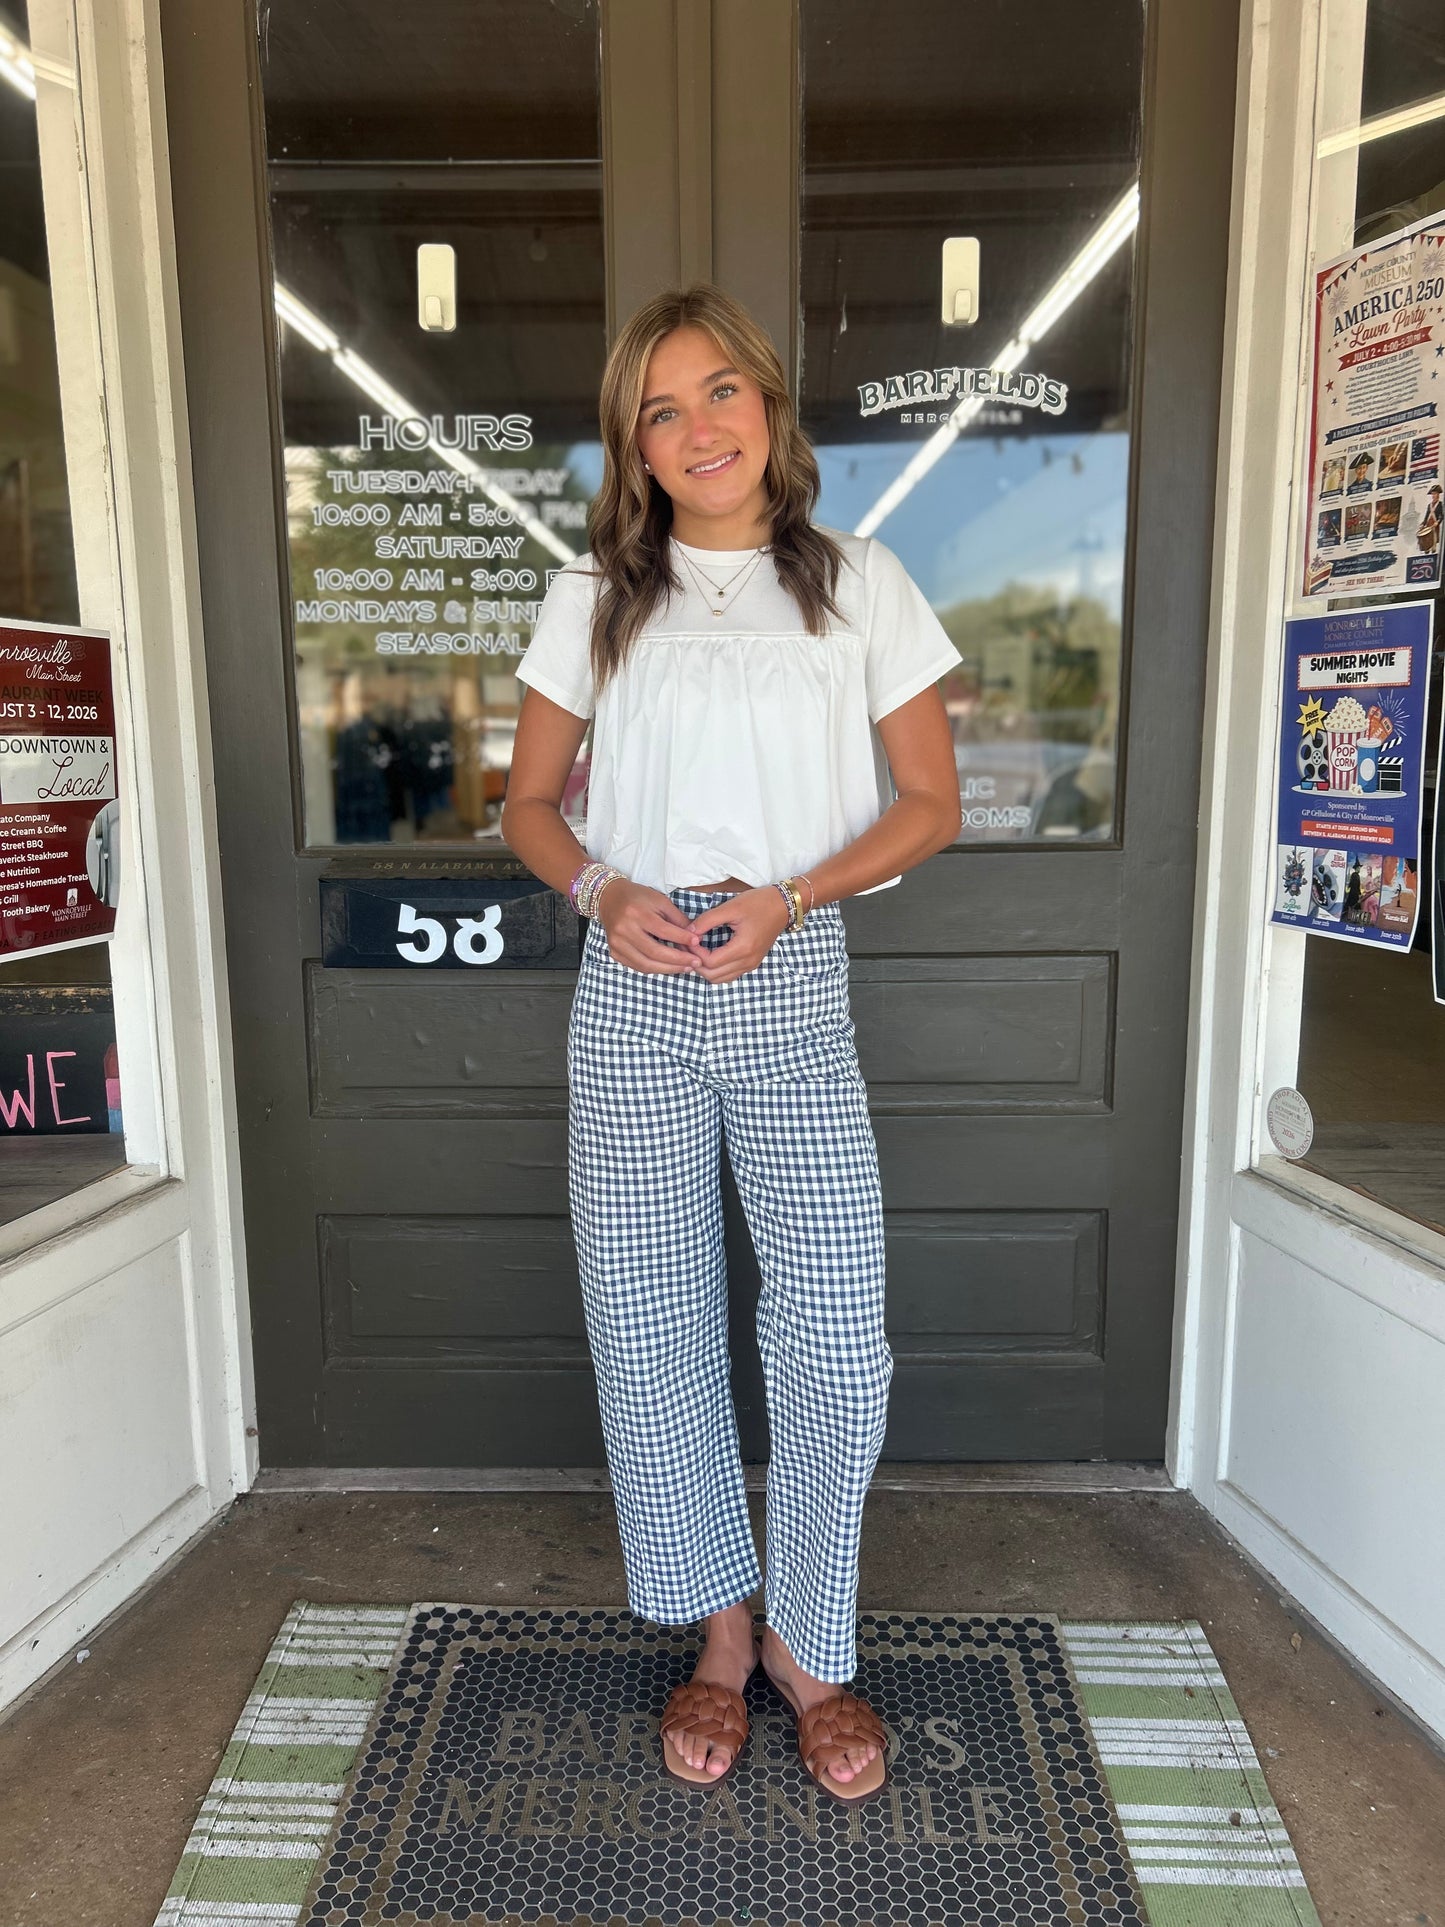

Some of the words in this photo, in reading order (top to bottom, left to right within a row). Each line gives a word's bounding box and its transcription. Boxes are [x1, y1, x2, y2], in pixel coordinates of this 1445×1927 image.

[1364, 264, 1412, 290] MUSEUM
[1333, 284, 1414, 338] AMERICA
[1416, 277, 1445, 302] 250
[1349, 322, 1390, 348] Lawn
[1393, 305, 1426, 333] Party
[1352, 348, 1370, 363] JULY
[1370, 348, 1376, 358] 2
[857, 366, 1069, 418] BARFIELD'S
[360, 414, 533, 451] HOURS
[313, 503, 391, 526] 10:00
[398, 504, 442, 526] AM
[375, 536, 524, 558] SATURDAY
[314, 568, 392, 592] 10:00
[400, 568, 444, 591] AM
[471, 568, 537, 592] 3:00
[296, 600, 436, 624] MONDAYS
[444, 602, 467, 624] &
[1354, 628, 1384, 638] COUNTY
[375, 632, 527, 656] SEASONAL
[1310, 654, 1356, 672] SUMMER
[1358, 652, 1396, 668] MOVIE
[26, 664, 54, 680] Main
[55, 666, 82, 682] Street
[1336, 671, 1368, 684] NIGHTS
[64, 689, 103, 704] WEEK
[28, 704, 36, 718] 3
[48, 704, 64, 721] 12,
[66, 705, 98, 720] 2026
[1305, 709, 1319, 720] FREE
[0, 738, 96, 754] DOWNTOWN
[100, 740, 108, 754] &
[1336, 746, 1355, 757] POP
[1334, 758, 1354, 768] CORN
[38, 756, 109, 798] Local
[1328, 802, 1358, 810] Sponsored
[1358, 802, 1368, 812] by:
[14, 814, 50, 824] Company
[1311, 810, 1336, 818] Cellulose
[1342, 812, 1352, 820] City
[1354, 812, 1360, 820] of
[1360, 814, 1394, 822] Monroeville
[10, 828, 36, 836] Cream
[37, 826, 42, 834] &
[44, 824, 68, 834] Coffee
[2, 842, 25, 850] Street
[26, 840, 44, 849] BBQ
[27, 851, 68, 862] Steakhouse
[6, 866, 40, 877] Nutrition
[373, 862, 394, 870] 58
[400, 862, 411, 870] N
[418, 862, 494, 870] ALABAMA
[502, 862, 529, 870] AV
[26, 876, 66, 888] Homemade
[68, 874, 88, 882] Treats
[4, 894, 18, 904] Grill
[2, 907, 24, 918] Tooth
[26, 904, 50, 914] Bakery
[52, 904, 92, 917] MONROEVILLE
[70, 911, 88, 920] STREET
[1312, 918, 1322, 926] June
[1345, 924, 1356, 932] June
[396, 903, 504, 964] 58
